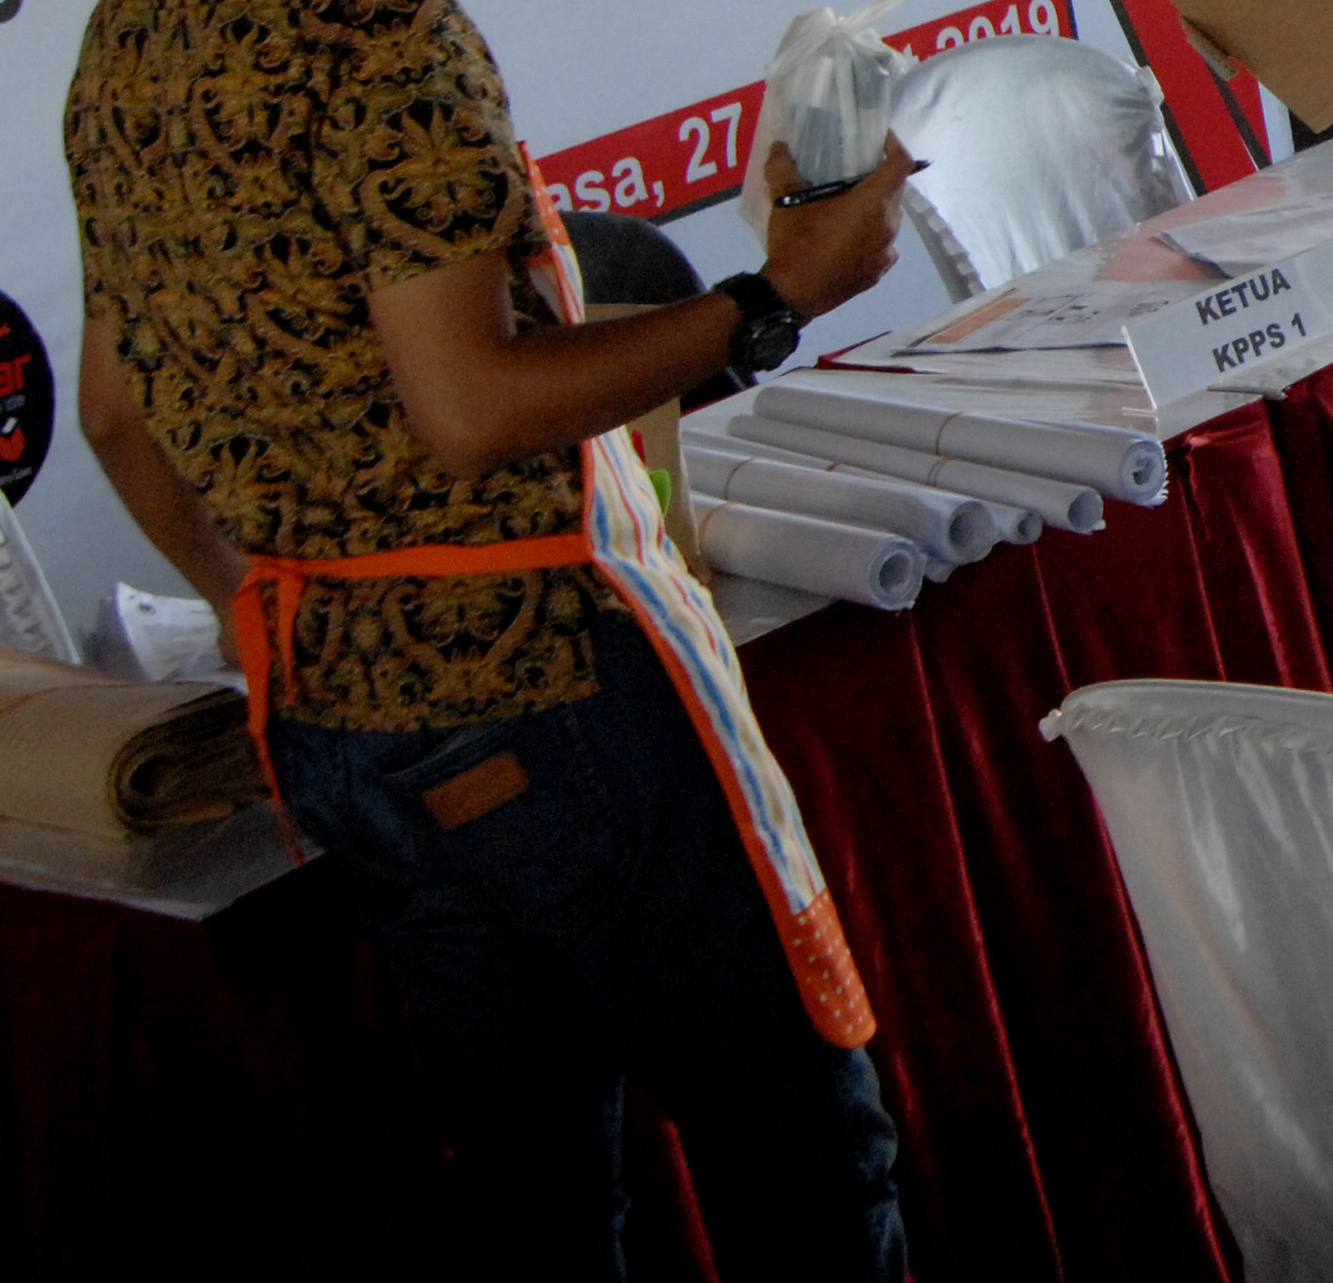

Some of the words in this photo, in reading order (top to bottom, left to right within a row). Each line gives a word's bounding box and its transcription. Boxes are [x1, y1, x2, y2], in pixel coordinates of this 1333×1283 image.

[678, 102, 743, 183] 27
[1195, 268, 1292, 326] KETUA
[1212, 323, 1286, 373] KPPS
[1291, 312, 1307, 337] 1
